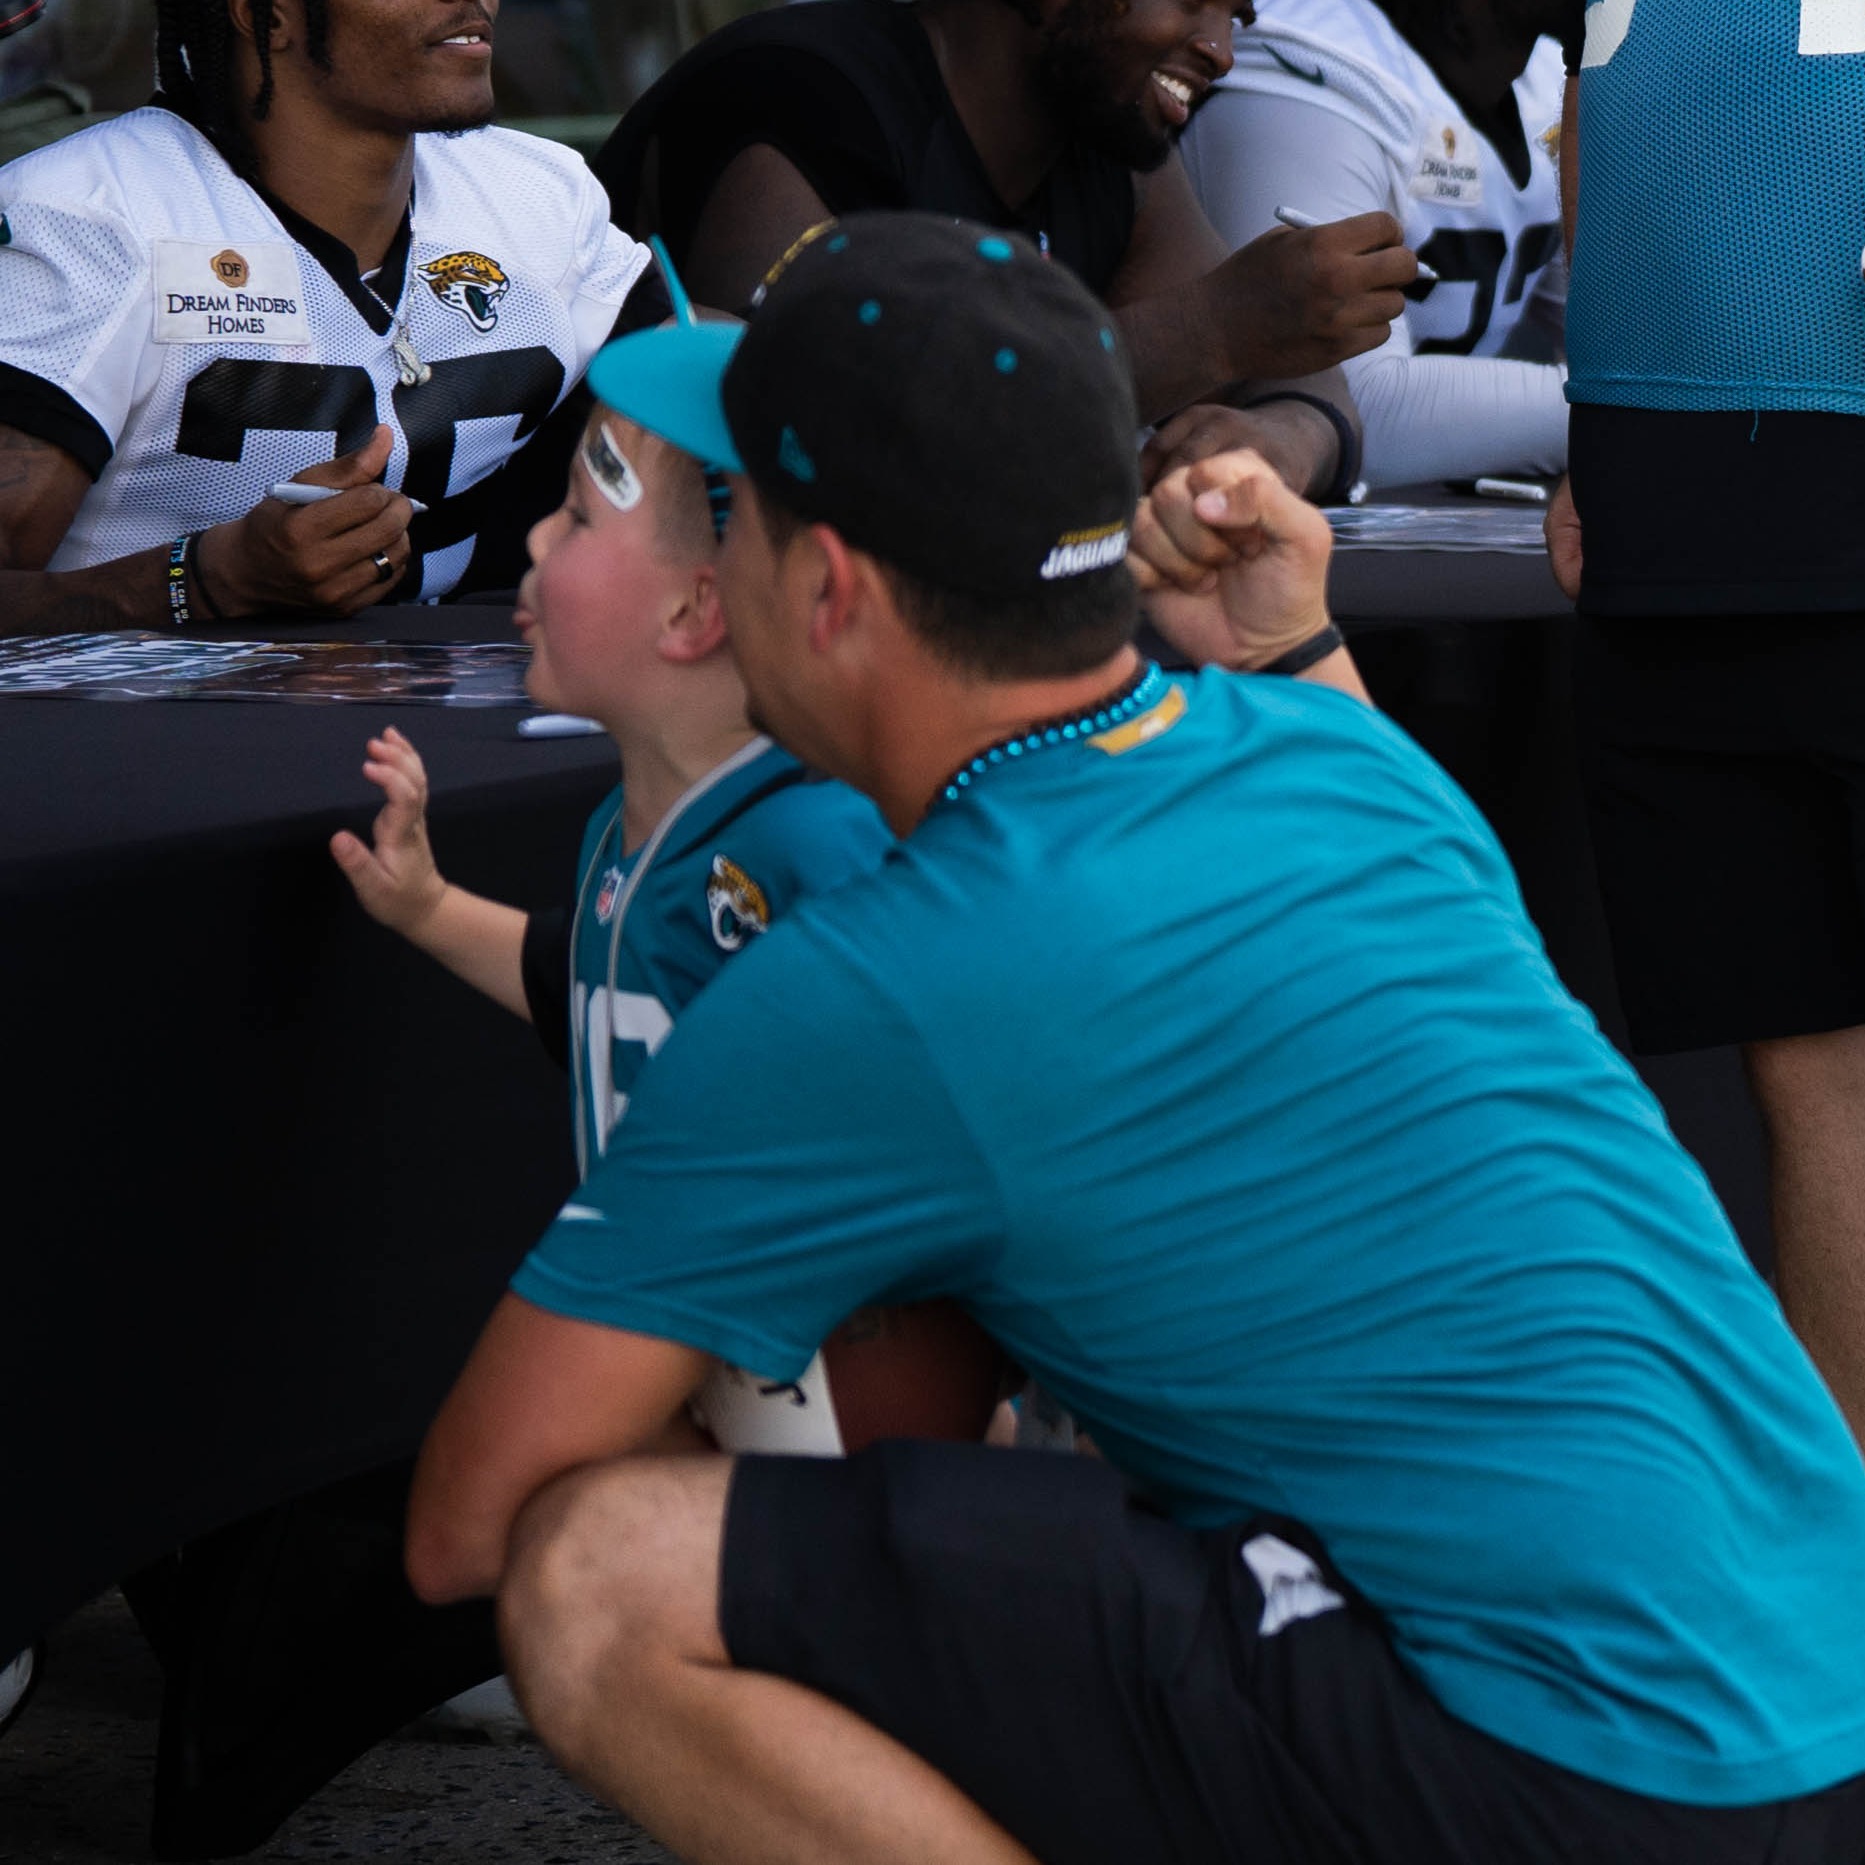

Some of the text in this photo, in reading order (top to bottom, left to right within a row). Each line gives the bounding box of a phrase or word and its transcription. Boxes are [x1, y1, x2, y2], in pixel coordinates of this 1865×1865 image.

[220, 261, 243, 278] DF
[166, 293, 298, 315] DREAM FINDERS
[207, 314, 266, 335] HOMES
